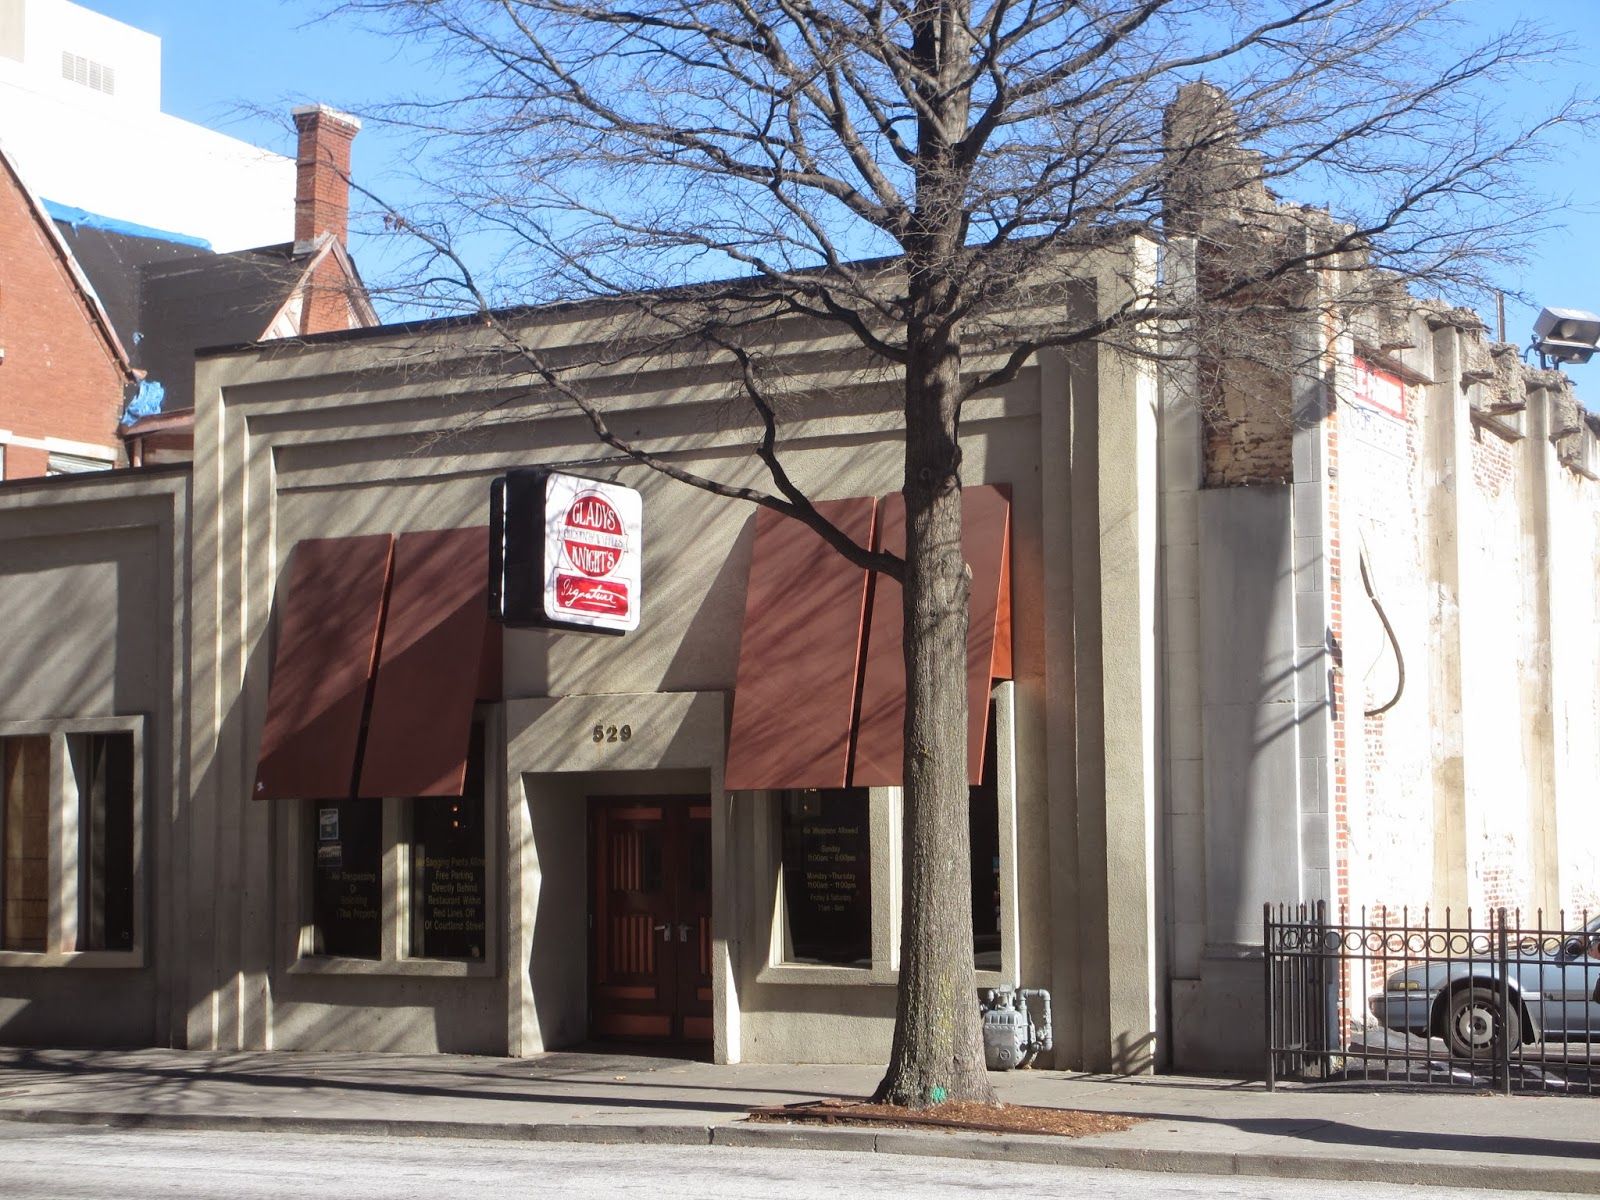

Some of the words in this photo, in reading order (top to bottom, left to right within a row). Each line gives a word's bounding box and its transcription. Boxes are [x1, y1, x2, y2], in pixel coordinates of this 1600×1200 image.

[572, 501, 616, 531] GLADYS
[571, 546, 615, 573] KNIGHT'S
[561, 578, 624, 607] Signature
[592, 724, 632, 743] 529
[435, 870, 449, 880] Free
[450, 870, 473, 881] Parking
[431, 882, 455, 894] Directly
